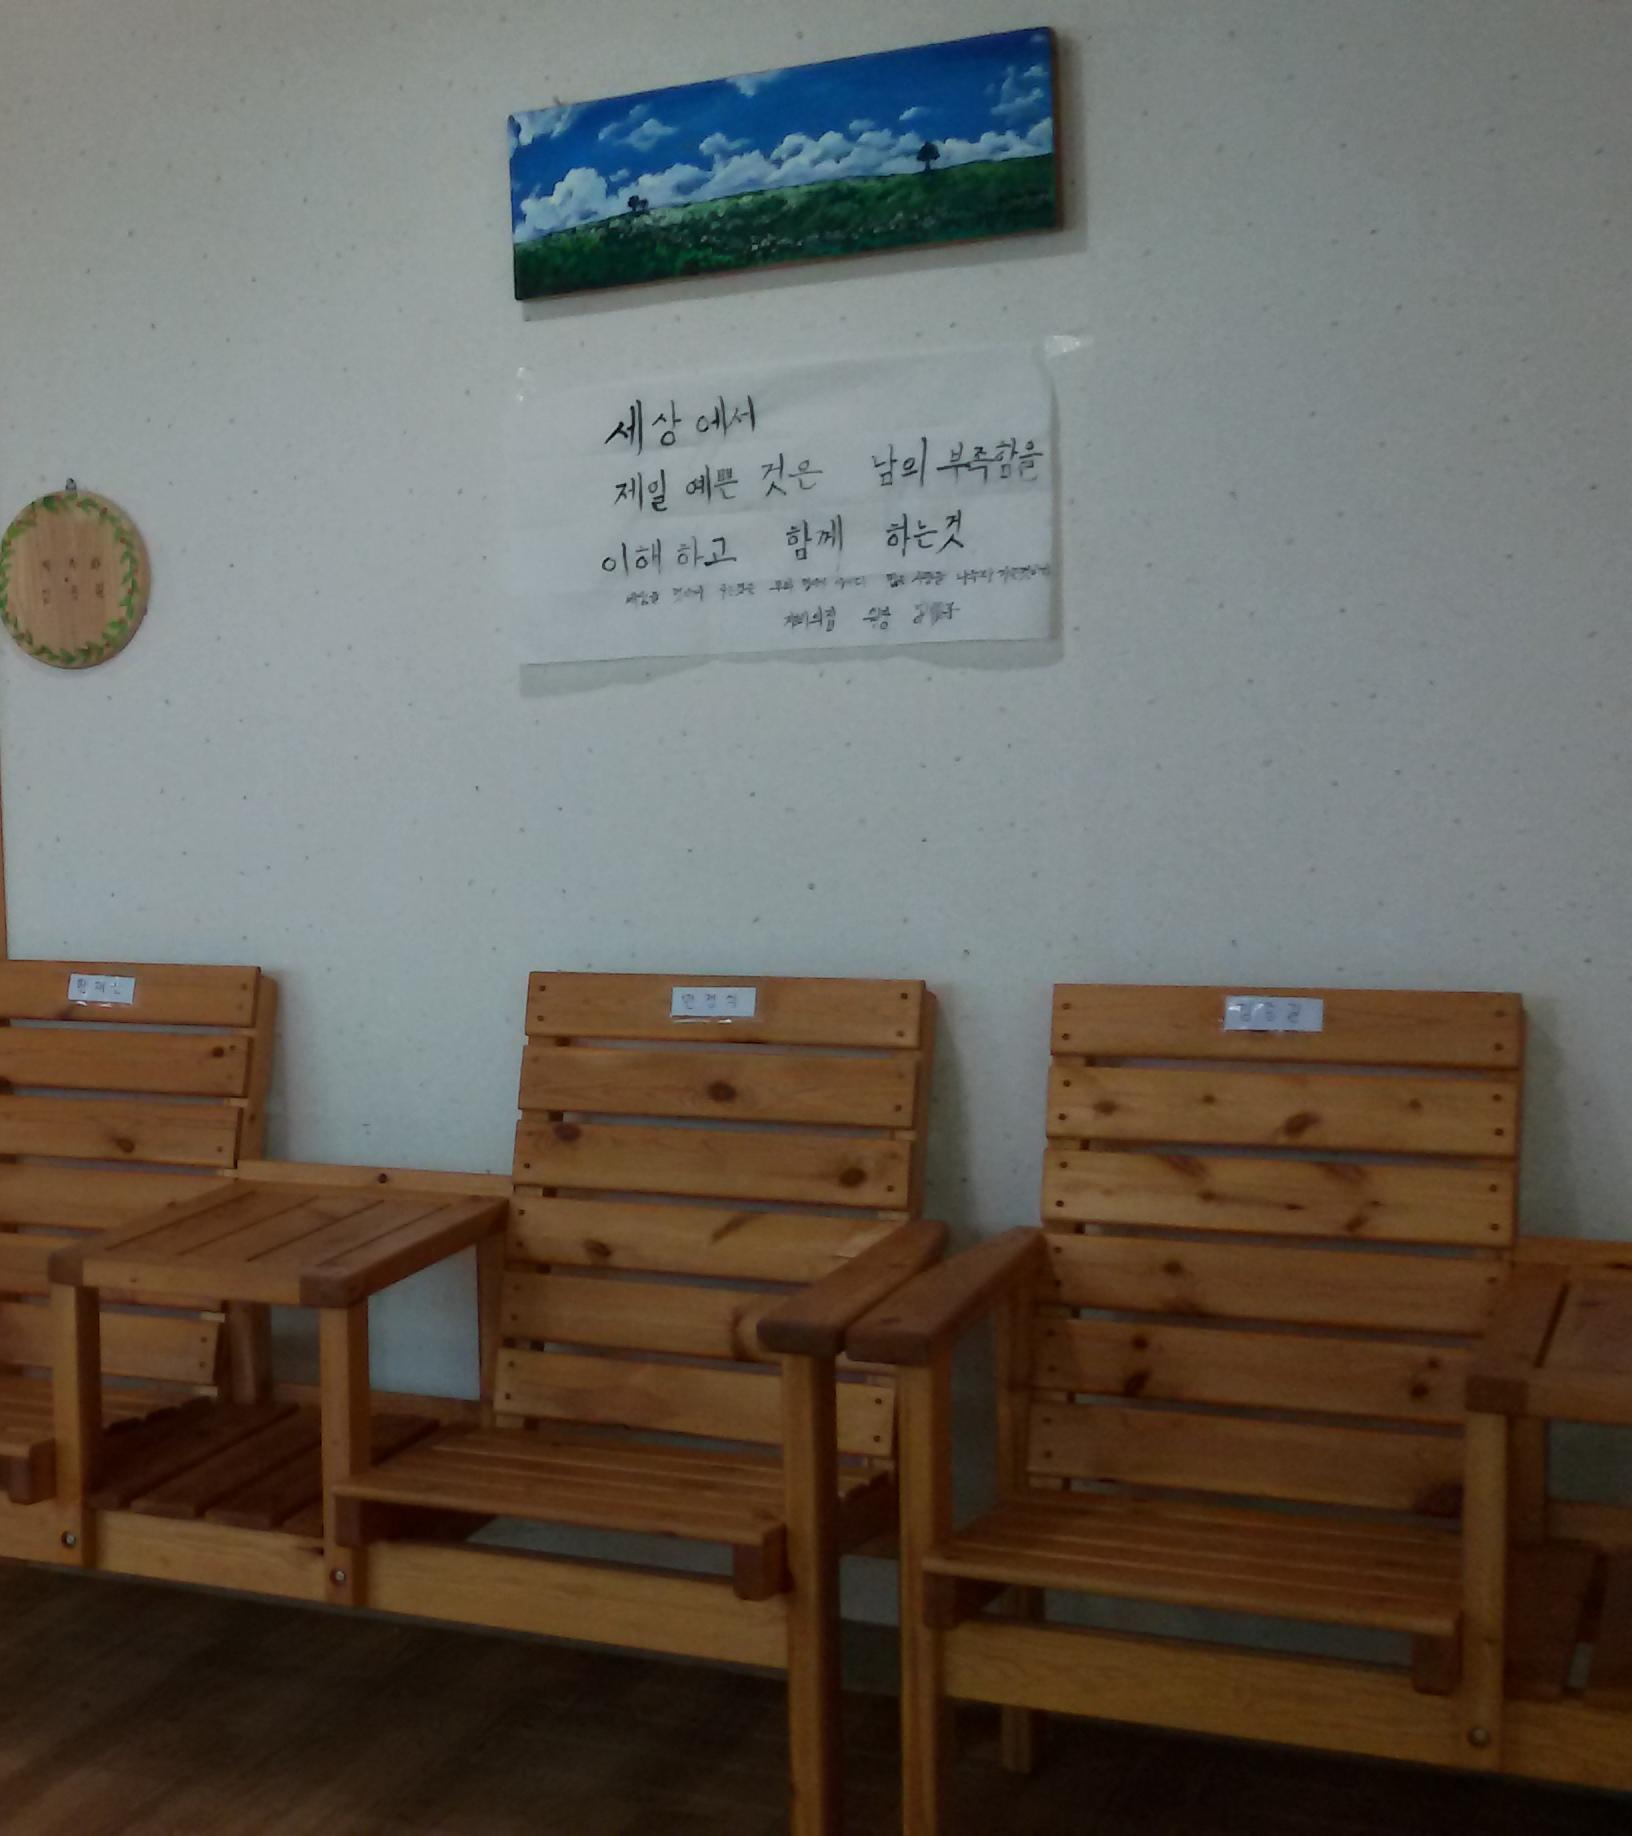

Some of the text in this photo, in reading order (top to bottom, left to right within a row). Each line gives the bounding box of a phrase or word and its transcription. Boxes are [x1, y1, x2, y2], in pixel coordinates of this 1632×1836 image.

[614, 436, 1044, 512] 제일 예쁜 것은 남의 부족함을
[786, 514, 843, 560] 함께
